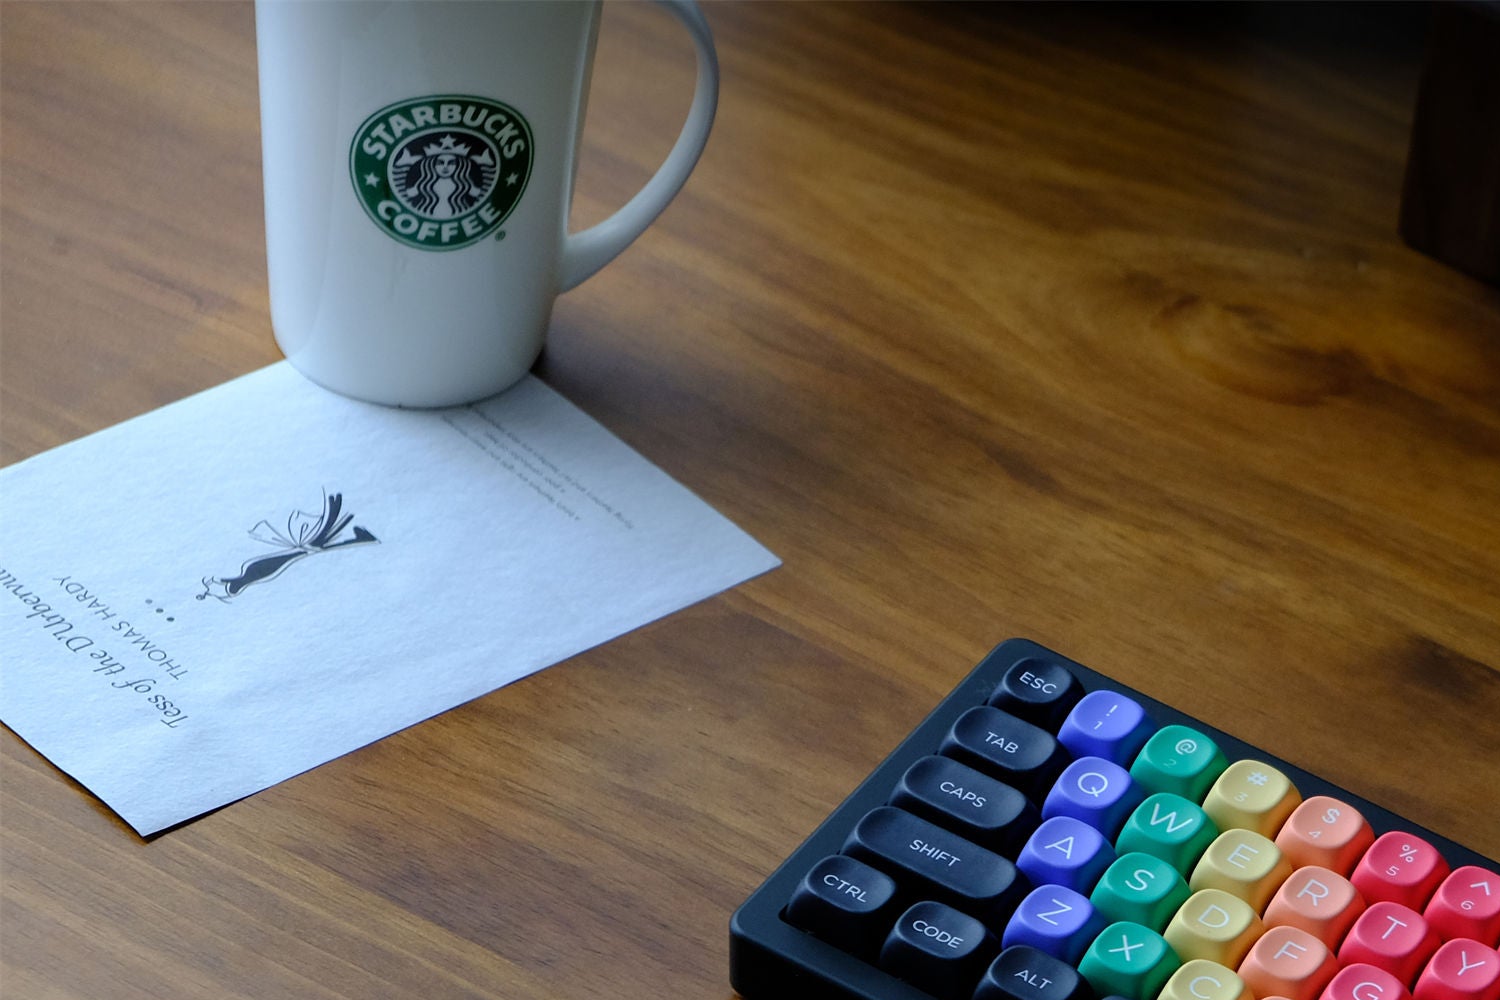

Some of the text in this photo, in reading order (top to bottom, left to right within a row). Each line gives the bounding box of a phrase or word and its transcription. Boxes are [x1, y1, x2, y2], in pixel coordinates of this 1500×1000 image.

[362, 103, 525, 161] STARBUCKS
[376, 199, 502, 244] COFFEE
[52, 575, 188, 681] THOMAS HARDY
[90, 649, 125, 676] the
[111, 678, 157, 694] of
[1019, 671, 1057, 694] ESC
[147, 693, 188, 729] Tess
[1106, 704, 1118, 717] !
[985, 731, 1019, 754] TAB
[1174, 738, 1198, 755] @
[1077, 772, 1109, 798] Q
[1247, 771, 1269, 787] #
[939, 781, 987, 808] CAPS
[1149, 802, 1194, 833] W
[1321, 808, 1341, 824] $
[909, 839, 961, 867] SHIFT
[1044, 836, 1075, 860] A
[1226, 843, 1260, 869] E
[1399, 844, 1418, 863] %
[1124, 869, 1155, 891] S
[1385, 865, 1400, 877] 5
[823, 874, 866, 903] CTRL
[1301, 879, 1329, 906] R
[1036, 898, 1073, 926] Z
[1197, 904, 1231, 929] D
[1460, 900, 1475, 911] 6
[912, 920, 964, 949] CODE
[1381, 915, 1408, 940] T
[1108, 934, 1144, 962] X
[1273, 940, 1307, 960] F
[1457, 950, 1486, 976] Y
[1014, 969, 1052, 989] ALT
[1188, 975, 1222, 1000] C
